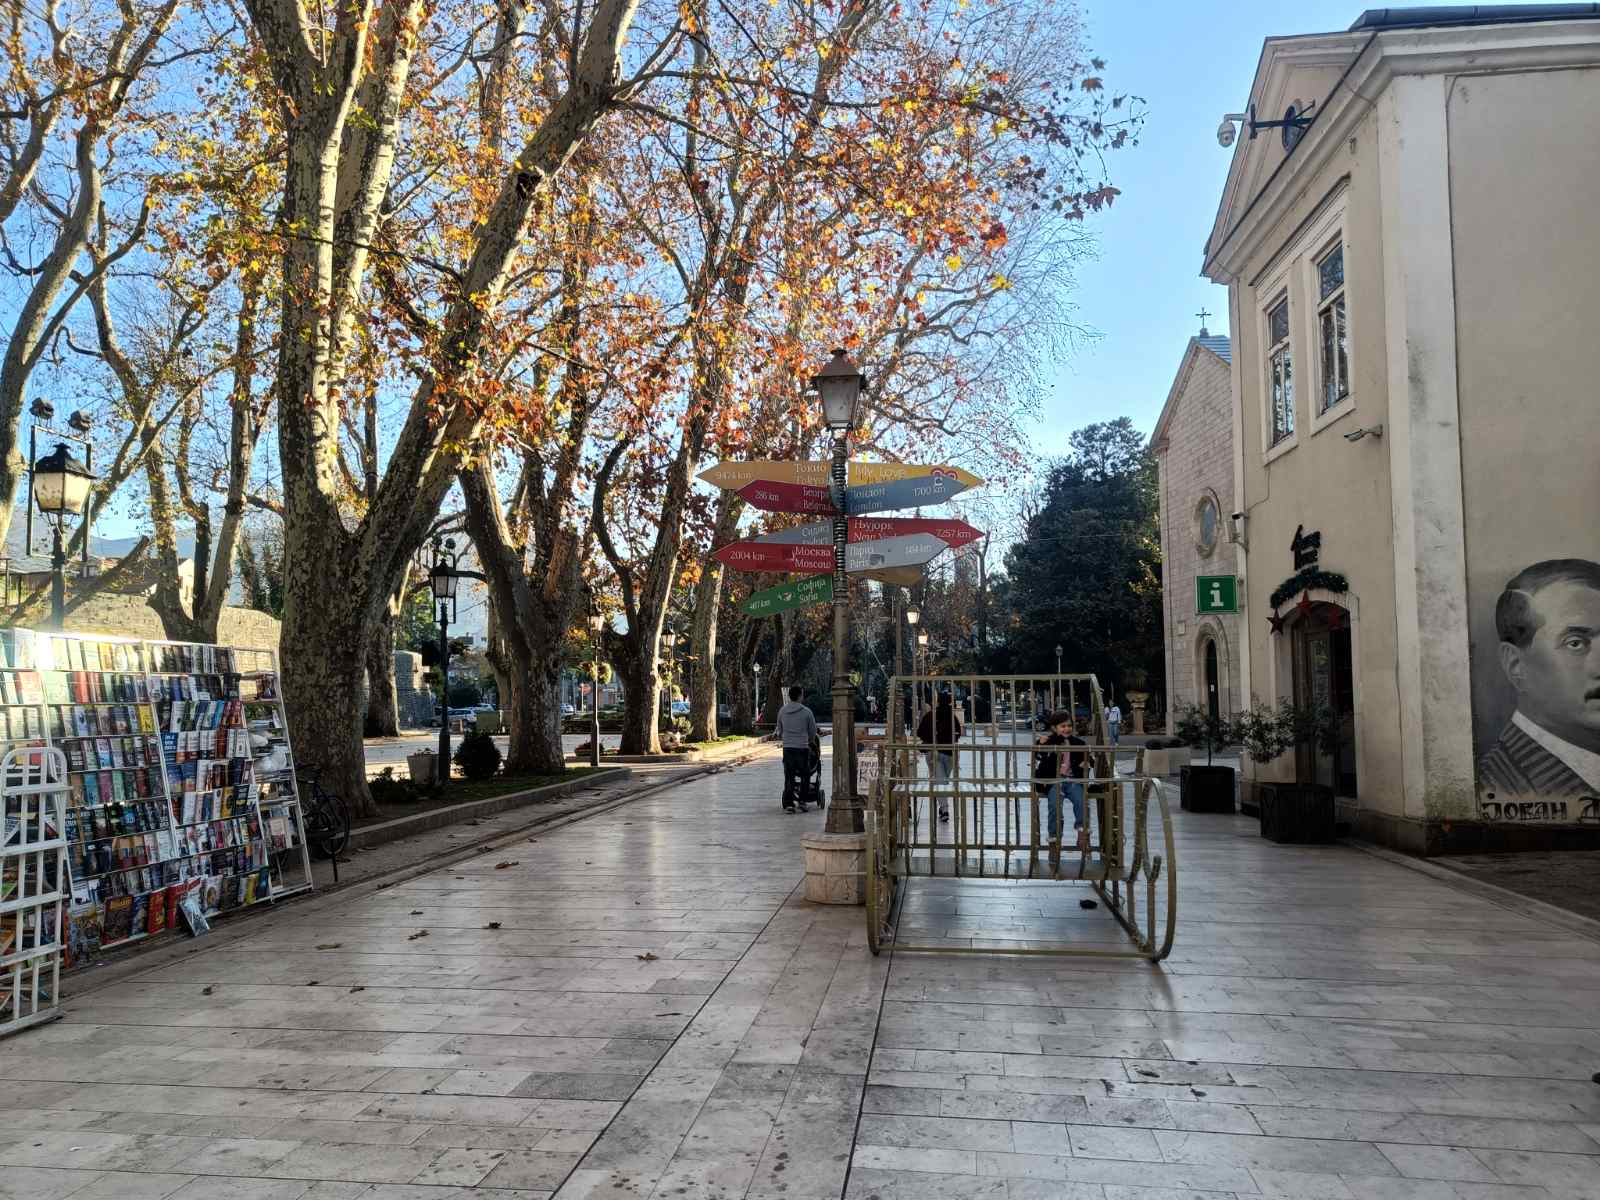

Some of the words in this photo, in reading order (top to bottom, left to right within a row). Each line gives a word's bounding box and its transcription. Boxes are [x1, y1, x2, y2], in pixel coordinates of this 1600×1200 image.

[932, 484, 946, 494] km
[769, 492, 780, 501] km
[957, 528, 972, 539] km
[729, 550, 751, 560] 2004
[752, 551, 766, 561] km
[795, 545, 831, 556] Москва
[795, 559, 832, 569] Moscow
